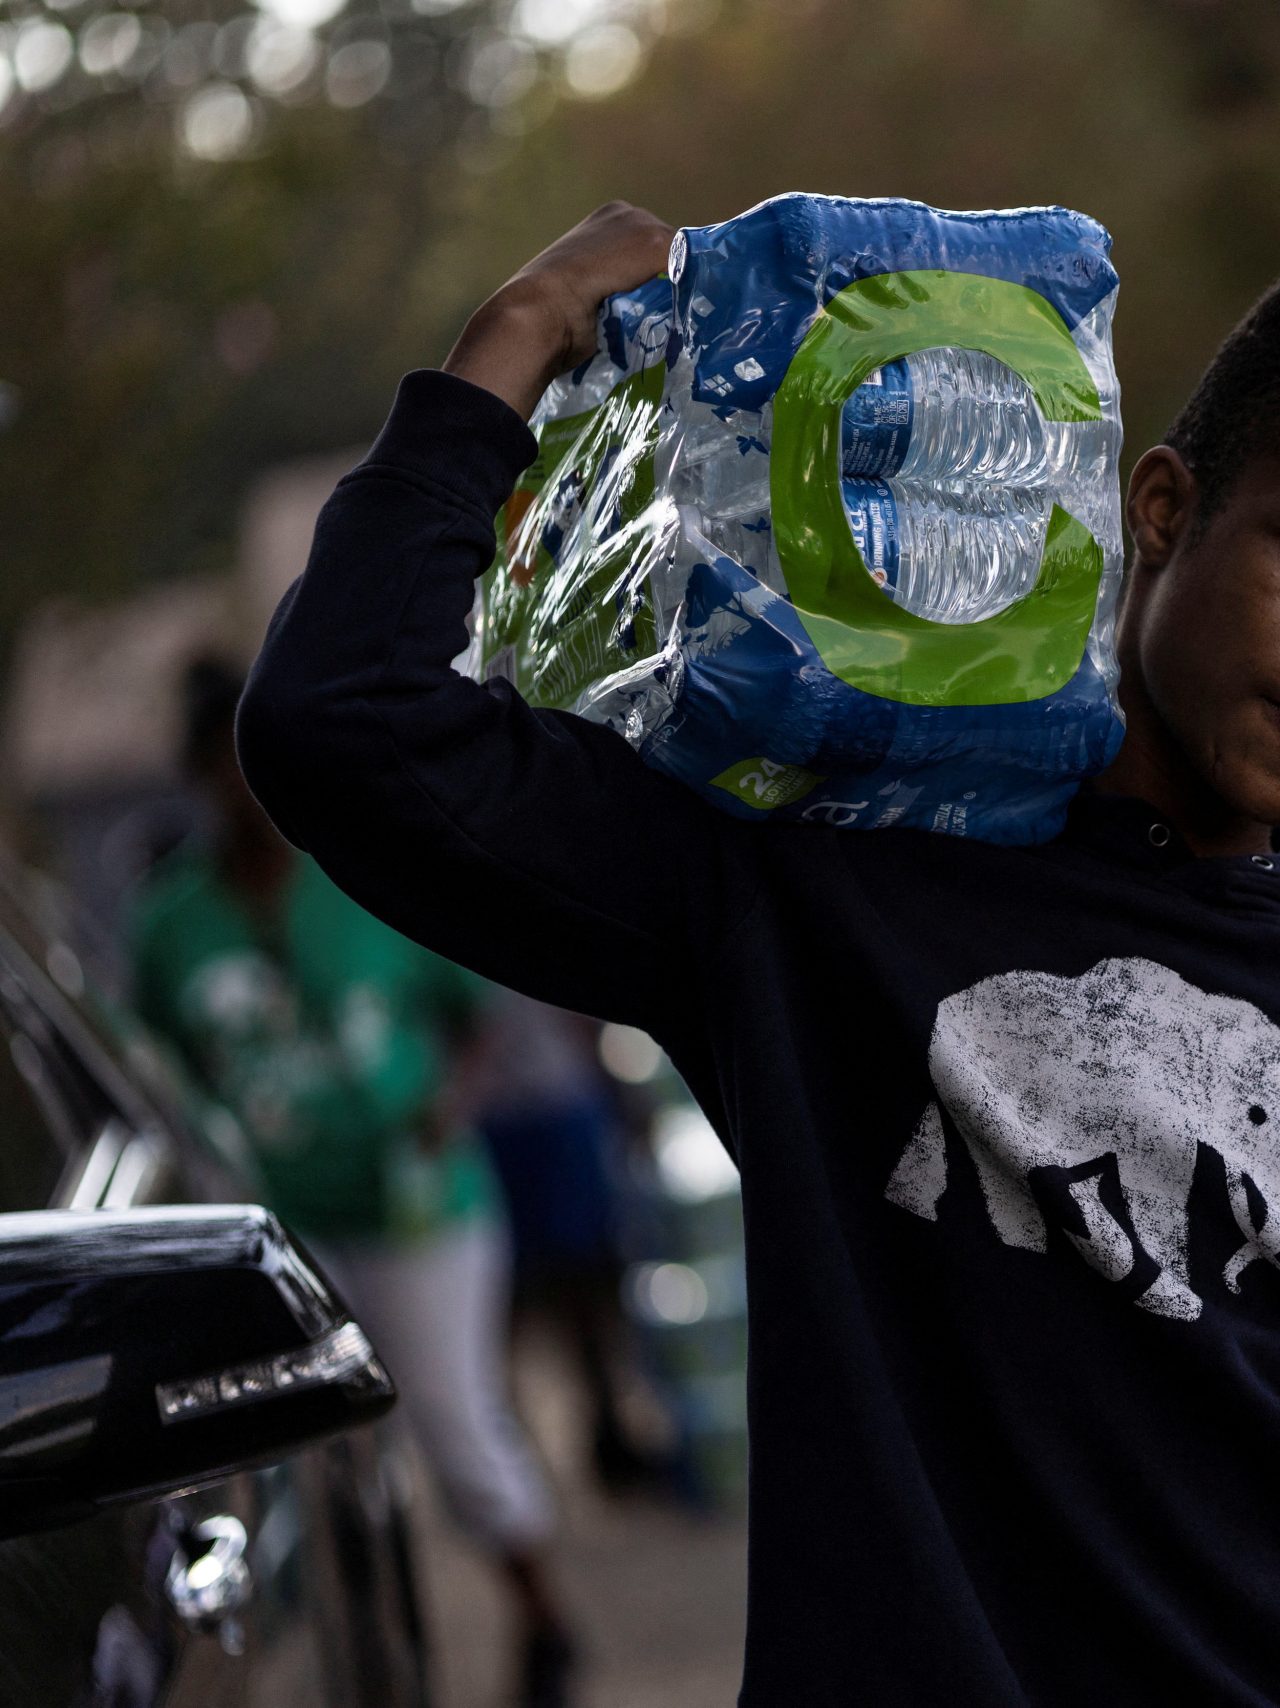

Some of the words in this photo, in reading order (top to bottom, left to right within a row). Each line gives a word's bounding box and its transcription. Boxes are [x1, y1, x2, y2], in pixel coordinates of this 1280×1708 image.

[871, 502, 882, 525] WATER
[872, 527, 884, 566] DRINKING
[738, 757, 787, 800] 24
[931, 803, 953, 833] ELLAS
